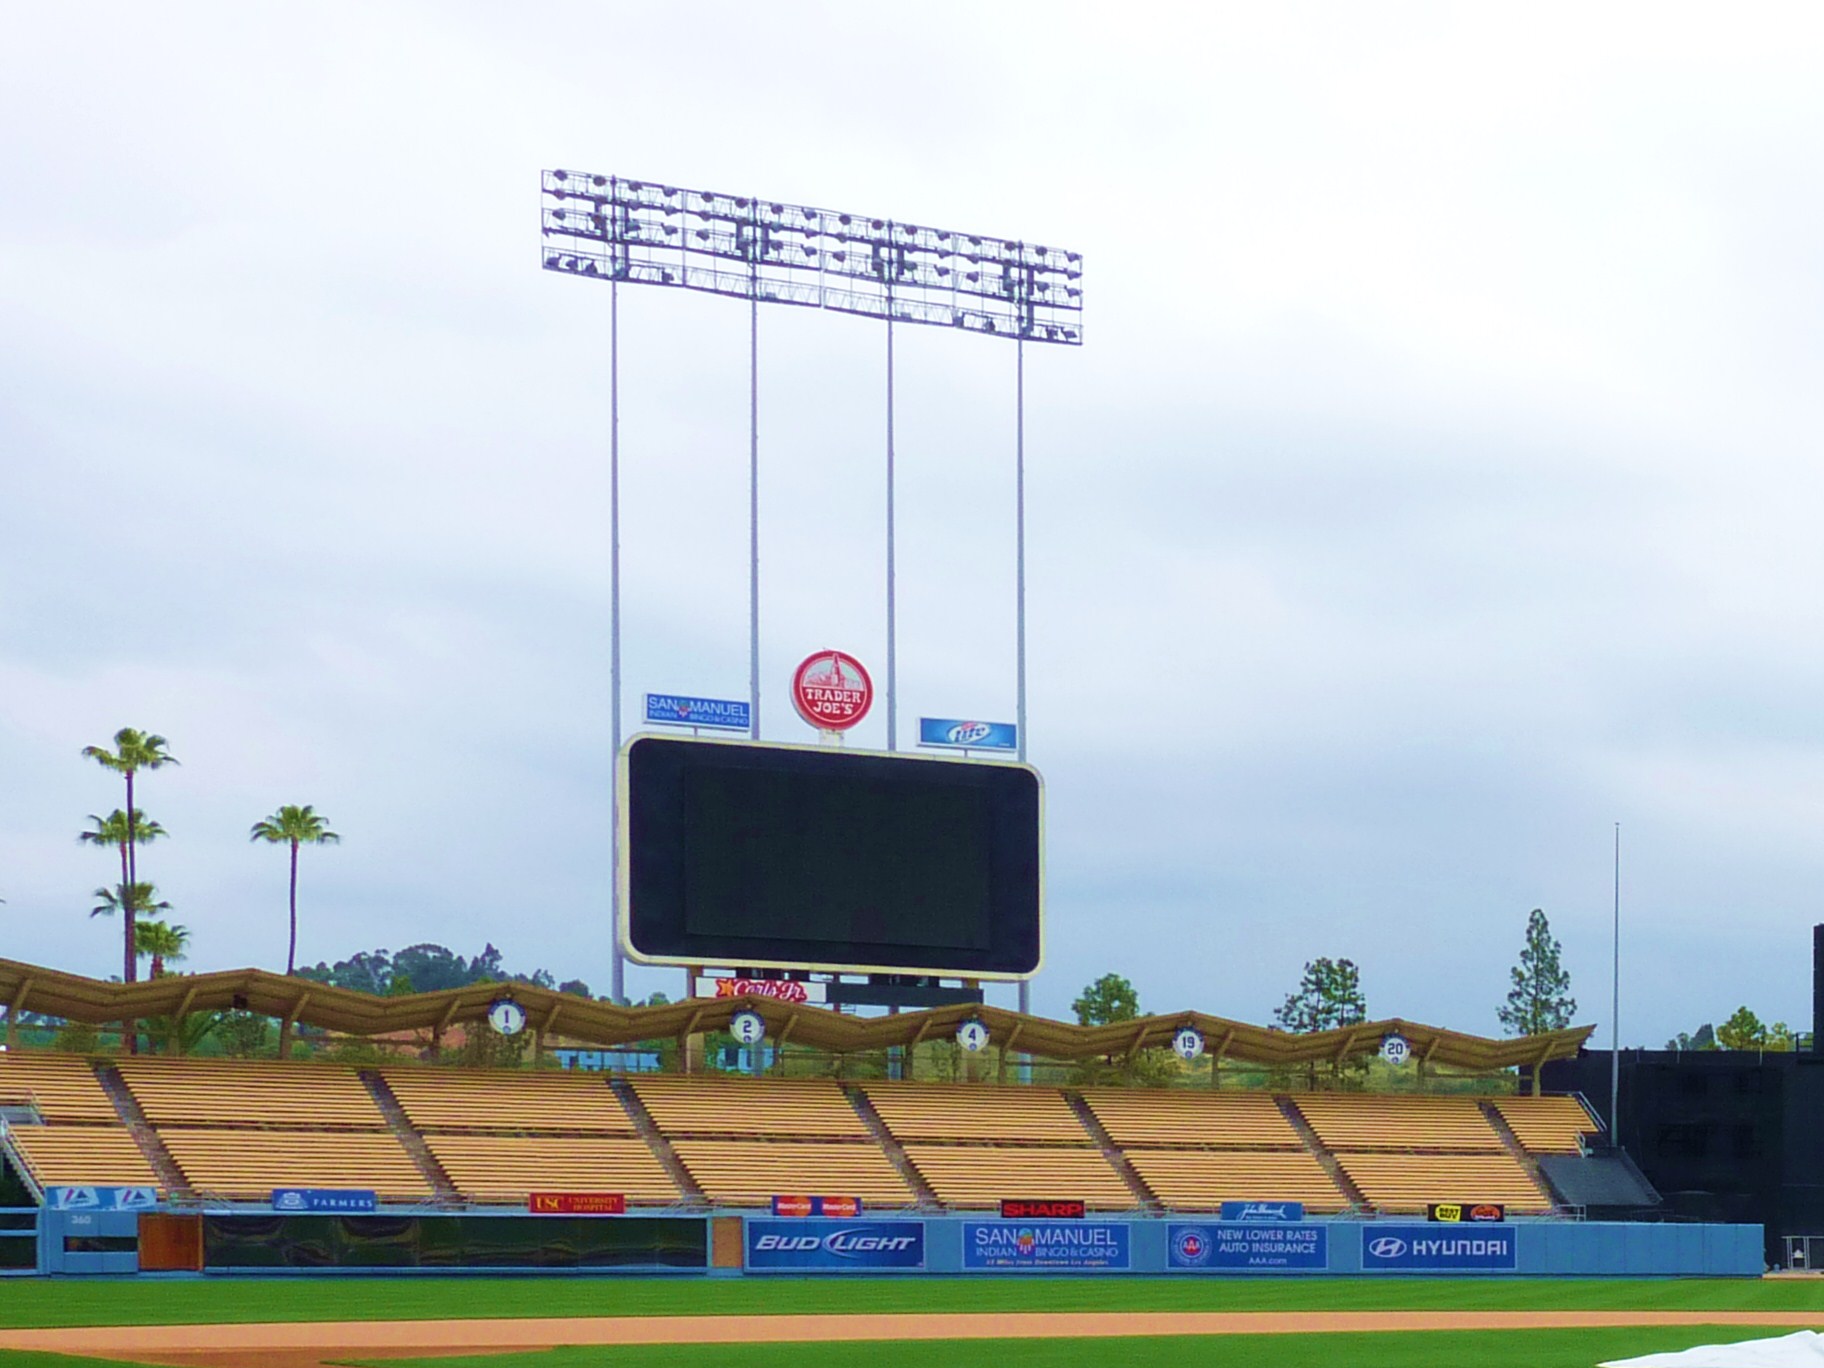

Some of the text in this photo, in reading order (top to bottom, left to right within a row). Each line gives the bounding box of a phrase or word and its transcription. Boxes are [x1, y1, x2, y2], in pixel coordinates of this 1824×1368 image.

[805, 688, 862, 703] TRADER
[648, 696, 748, 717] SAN MANUEL
[812, 701, 854, 715] JOE'S
[504, 1009, 510, 1024] 1
[743, 1019, 752, 1033] 2
[967, 1026, 977, 1042] 4
[1181, 1036, 1196, 1049] 19
[1387, 1042, 1403, 1056] 20
[313, 1198, 373, 1208] FARMERS
[1003, 1203, 1082, 1216] SHARP
[71, 1215, 92, 1225] 360
[755, 1235, 916, 1250] BUD LIGHT
[975, 1227, 1118, 1245] SAN MANUEL
[1217, 1230, 1318, 1241] NEW LOWER RATES
[976, 1247, 1017, 1257] INDIAN
[1035, 1247, 1069, 1257] BINGO
[1079, 1247, 1119, 1257] CASINO
[1219, 1242, 1316, 1254] AUTO INSURANCE
[1412, 1240, 1507, 1255] HYUNDAI
[1249, 1256, 1287, 1265] AAA.com
